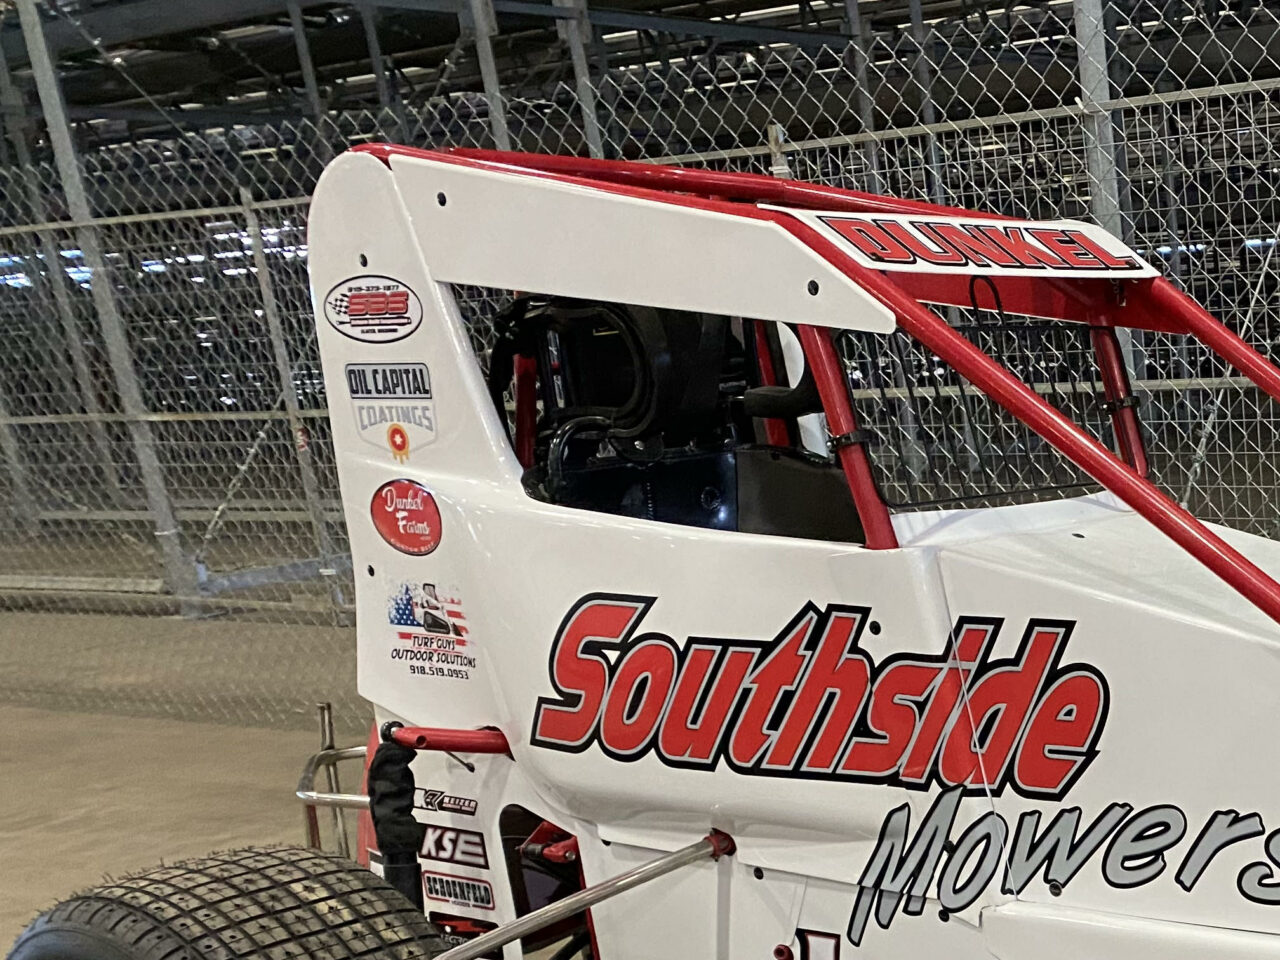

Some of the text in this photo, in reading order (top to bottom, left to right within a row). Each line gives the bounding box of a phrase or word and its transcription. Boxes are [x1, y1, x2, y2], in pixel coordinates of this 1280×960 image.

[817, 216, 1143, 271] DUNKEL
[347, 368, 430, 395] OIL CAPITAL
[358, 405, 433, 431] COATINGS
[412, 635, 455, 650] TURF GUYS
[391, 648, 476, 669] OUTDOOR SOLUTIONS
[409, 665, 469, 680] 918.519.0953
[530, 593, 1110, 801] Southside
[420, 826, 487, 867] KSE
[426, 875, 492, 905] SCHOENFELD
